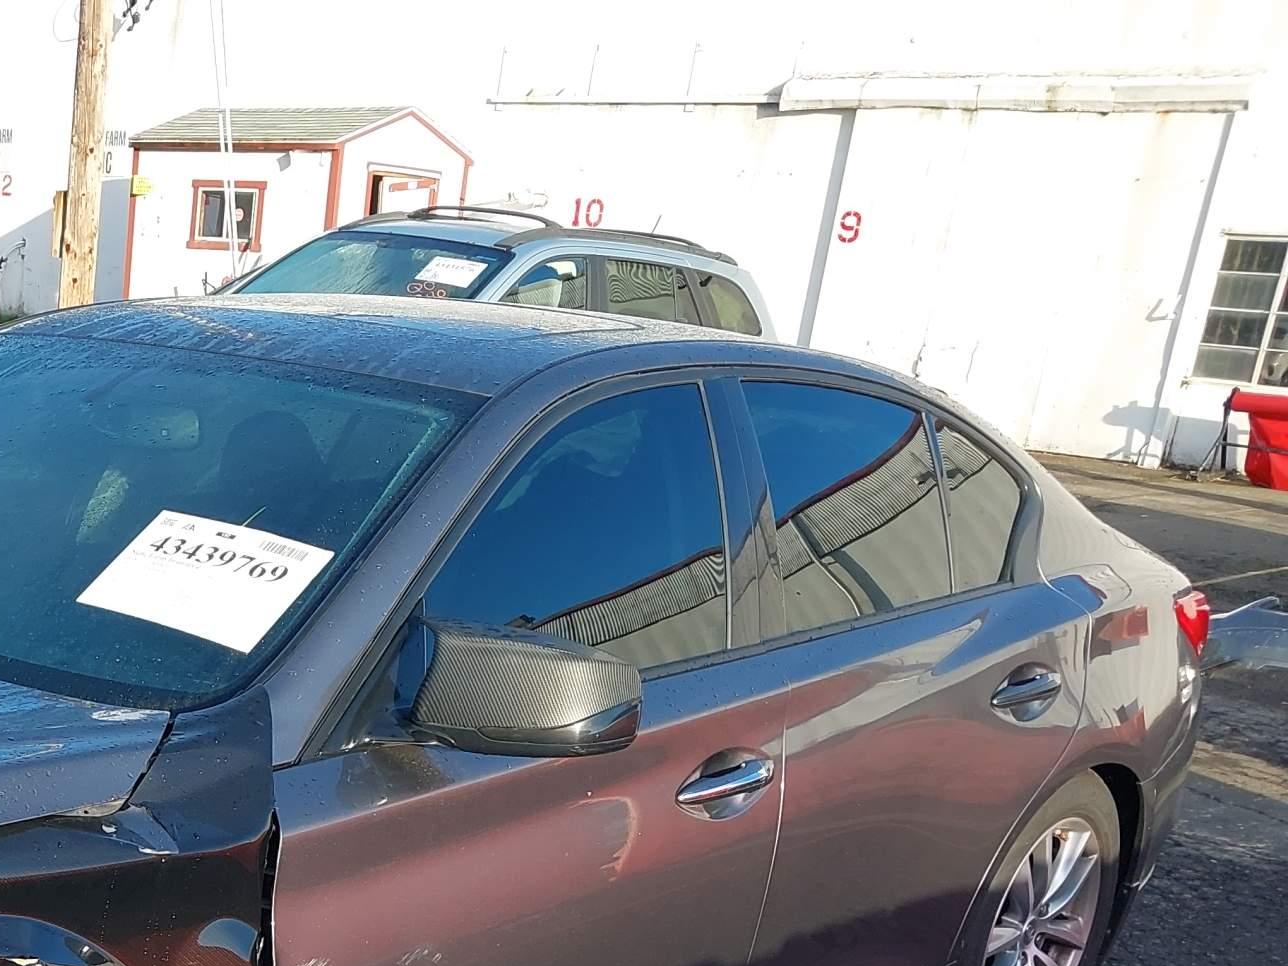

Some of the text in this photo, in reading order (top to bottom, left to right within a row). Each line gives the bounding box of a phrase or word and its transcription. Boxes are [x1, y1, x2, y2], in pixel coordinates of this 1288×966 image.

[104, 130, 127, 147] FARM
[571, 197, 605, 228] 10
[837, 210, 862, 243] 9
[149, 535, 289, 582] 43439769
